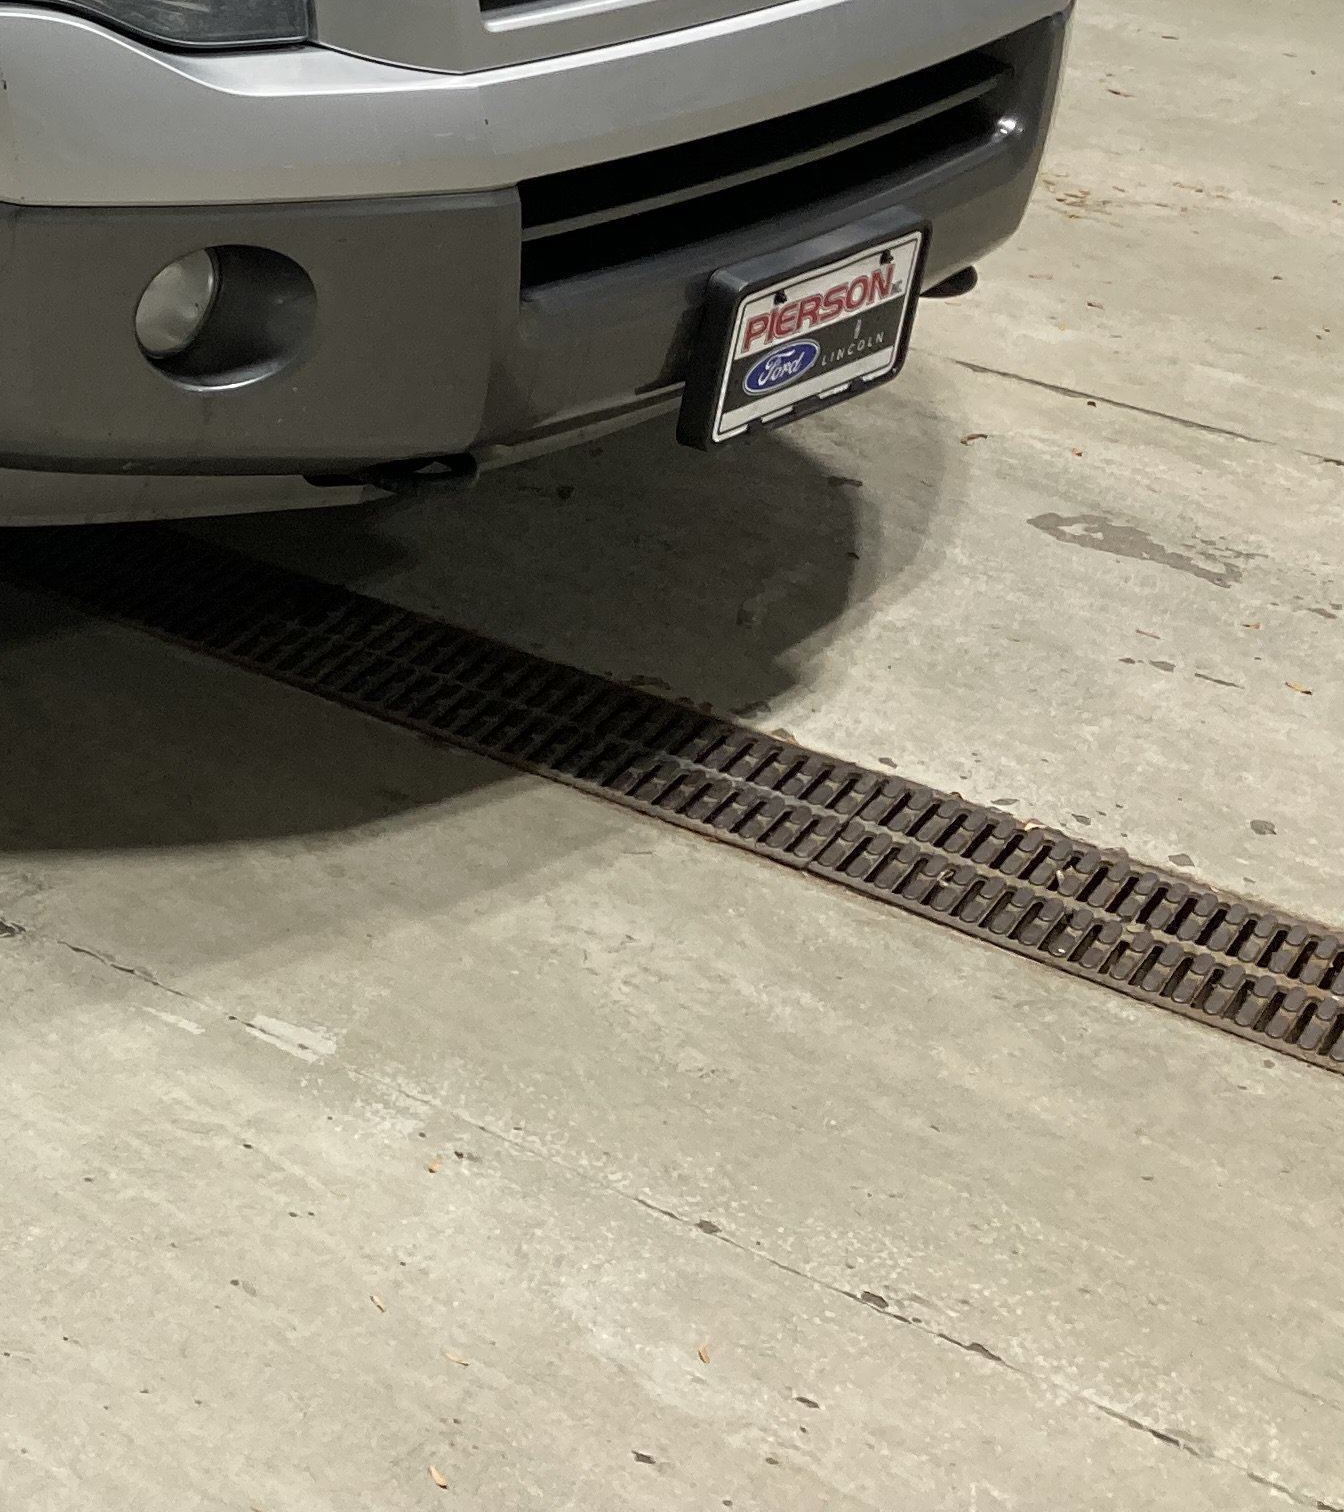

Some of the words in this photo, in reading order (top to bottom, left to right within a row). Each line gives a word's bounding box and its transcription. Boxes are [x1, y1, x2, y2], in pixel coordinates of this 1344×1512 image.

[741, 263, 896, 354] PIERSON
[758, 348, 806, 387] Ford
[821, 331, 885, 367] LINCOLN
